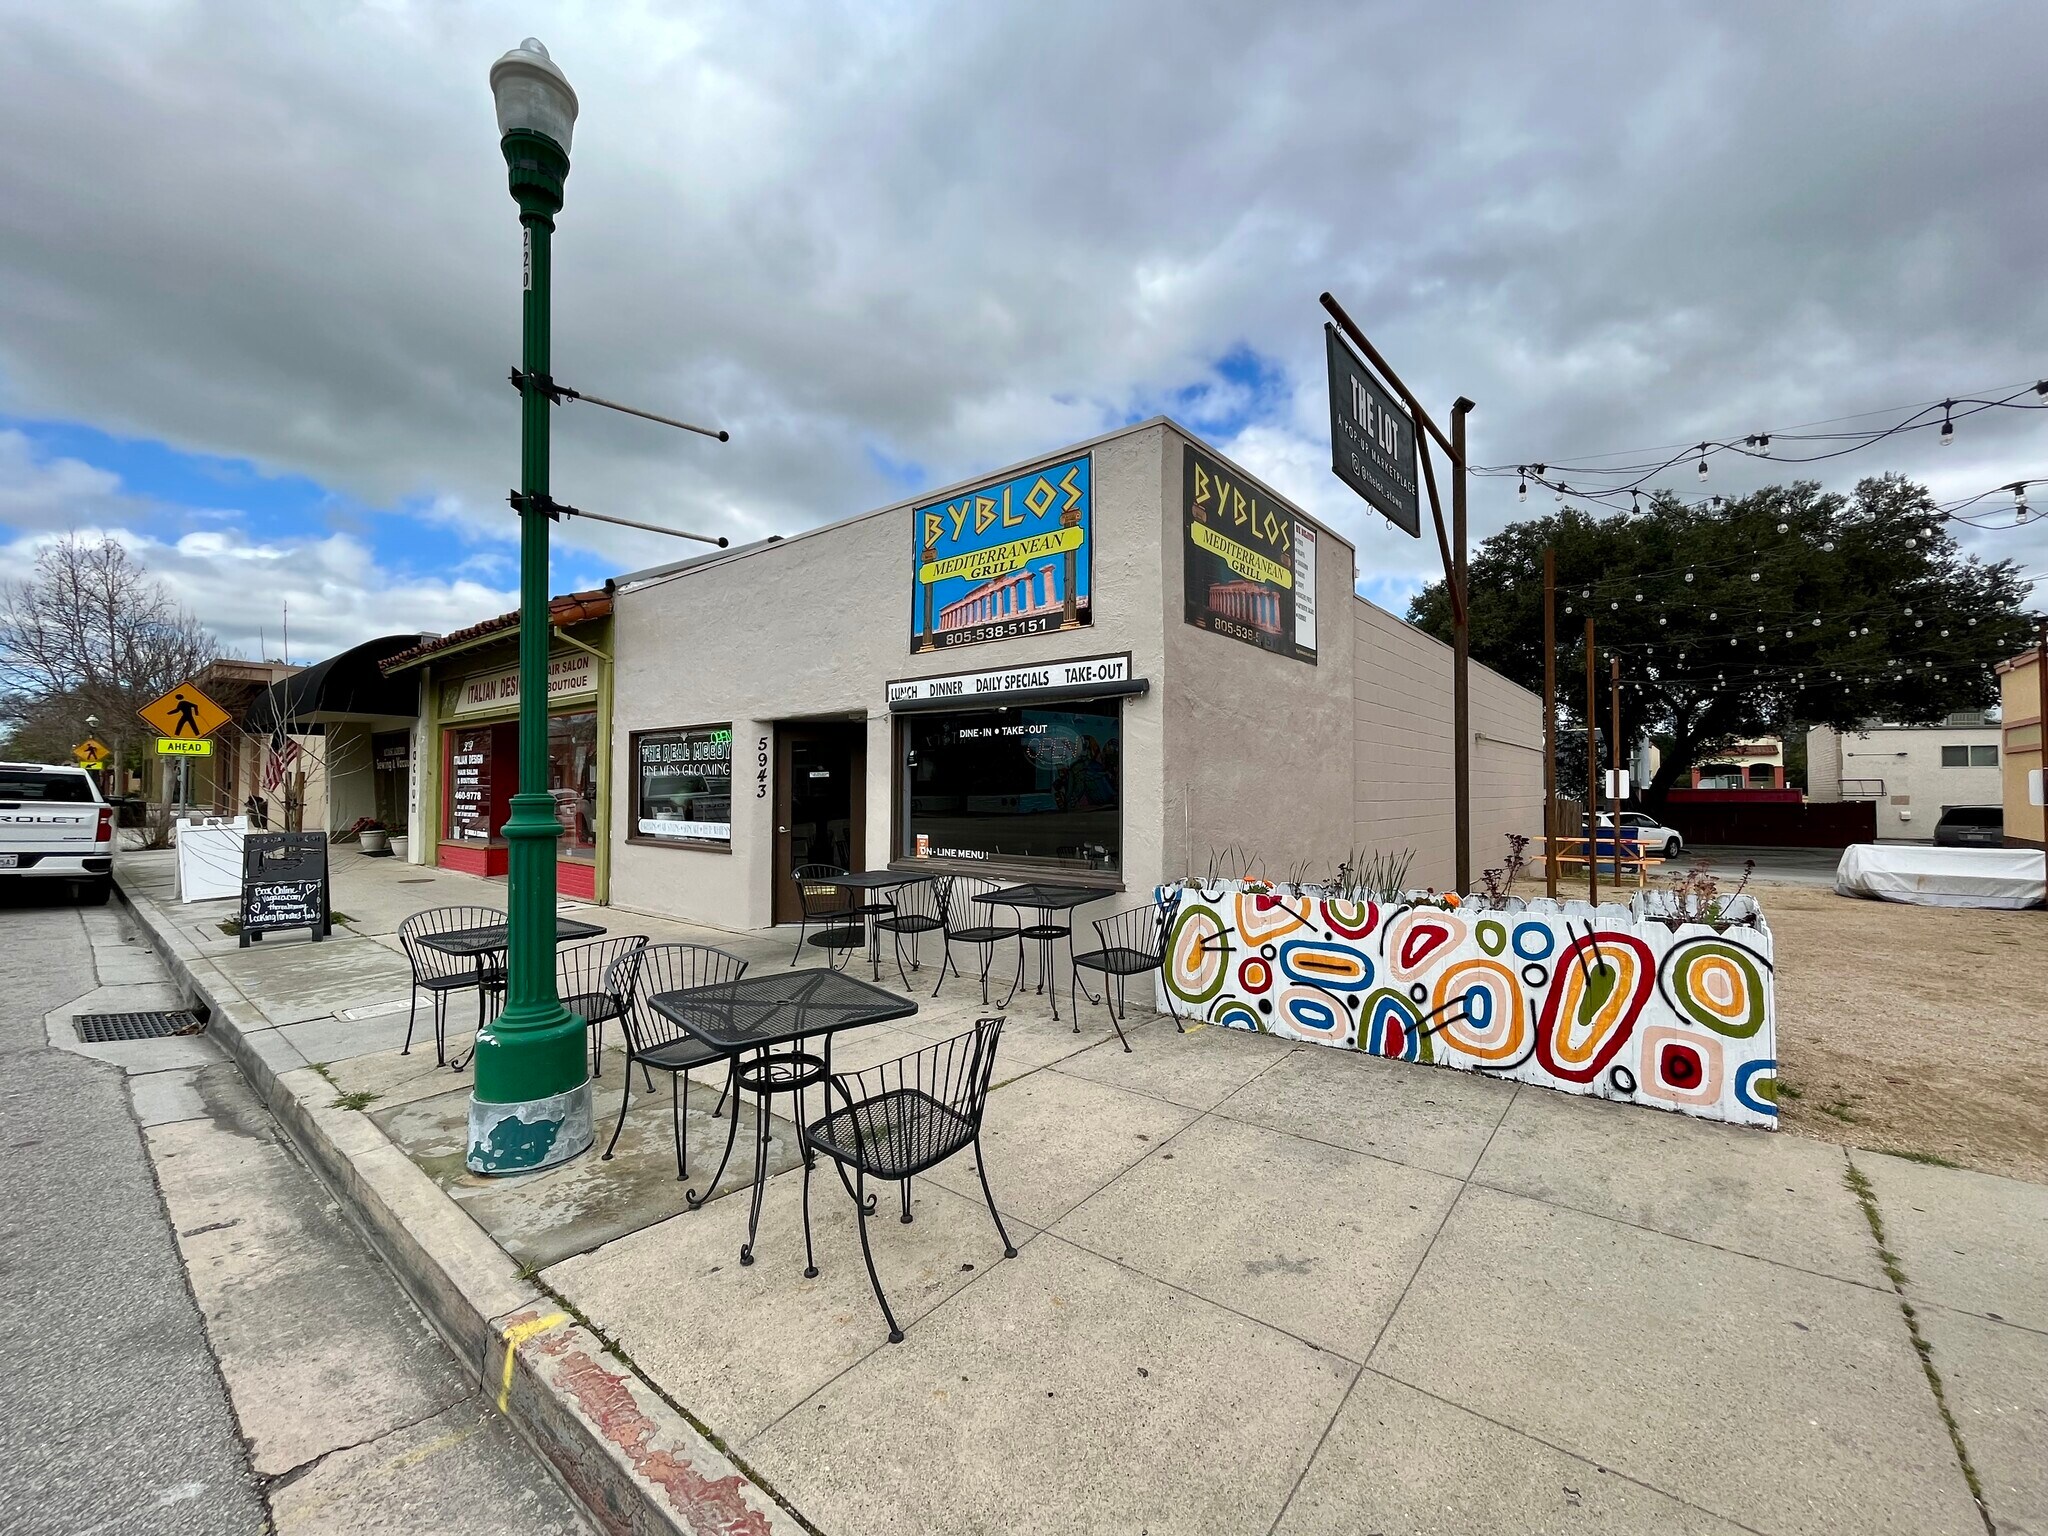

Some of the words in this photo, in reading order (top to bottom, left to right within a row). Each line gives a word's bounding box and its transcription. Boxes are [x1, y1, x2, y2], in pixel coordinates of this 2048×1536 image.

[1350, 374, 1374, 439] THE
[1377, 404, 1399, 461] LOT
[1337, 413, 1343, 426] A
[1344, 420, 1369, 454] POP-UP
[1371, 449, 1416, 496] MARKETPLACE
[924, 465, 1085, 550] BYBLOS
[1194, 461, 1291, 552] BYBLOS
[932, 532, 1066, 577] MEDITERRANEAN
[1202, 529, 1285, 581] MEDITERRANEAN
[970, 559, 1019, 580] GRILL
[1231, 559, 1262, 581] GRILL
[945, 618, 1048, 646] 805-538-5151
[548, 663, 560, 675] AIR
[562, 656, 589, 673] SALON
[467, 680, 497, 705] ITALIAN
[500, 675, 520, 698] DESI
[548, 675, 588, 692] BOUTIQUE
[890, 685, 918, 701] LUNCH
[929, 680, 963, 697] DINNER
[976, 676, 1003, 693] DAILY
[1004, 670, 1050, 690] SPECIALS
[1065, 662, 1123, 684] TAKE-OUT
[167, 743, 202, 752] AHEAD
[711, 730, 732, 744] OPEN
[642, 745, 661, 763] THE
[662, 743, 690, 764] REAL
[756, 737, 768, 798] 5943
[642, 765, 659, 777] FINE
[682, 763, 730, 776] GROOMING
[455, 791, 482, 801] 460-9778
